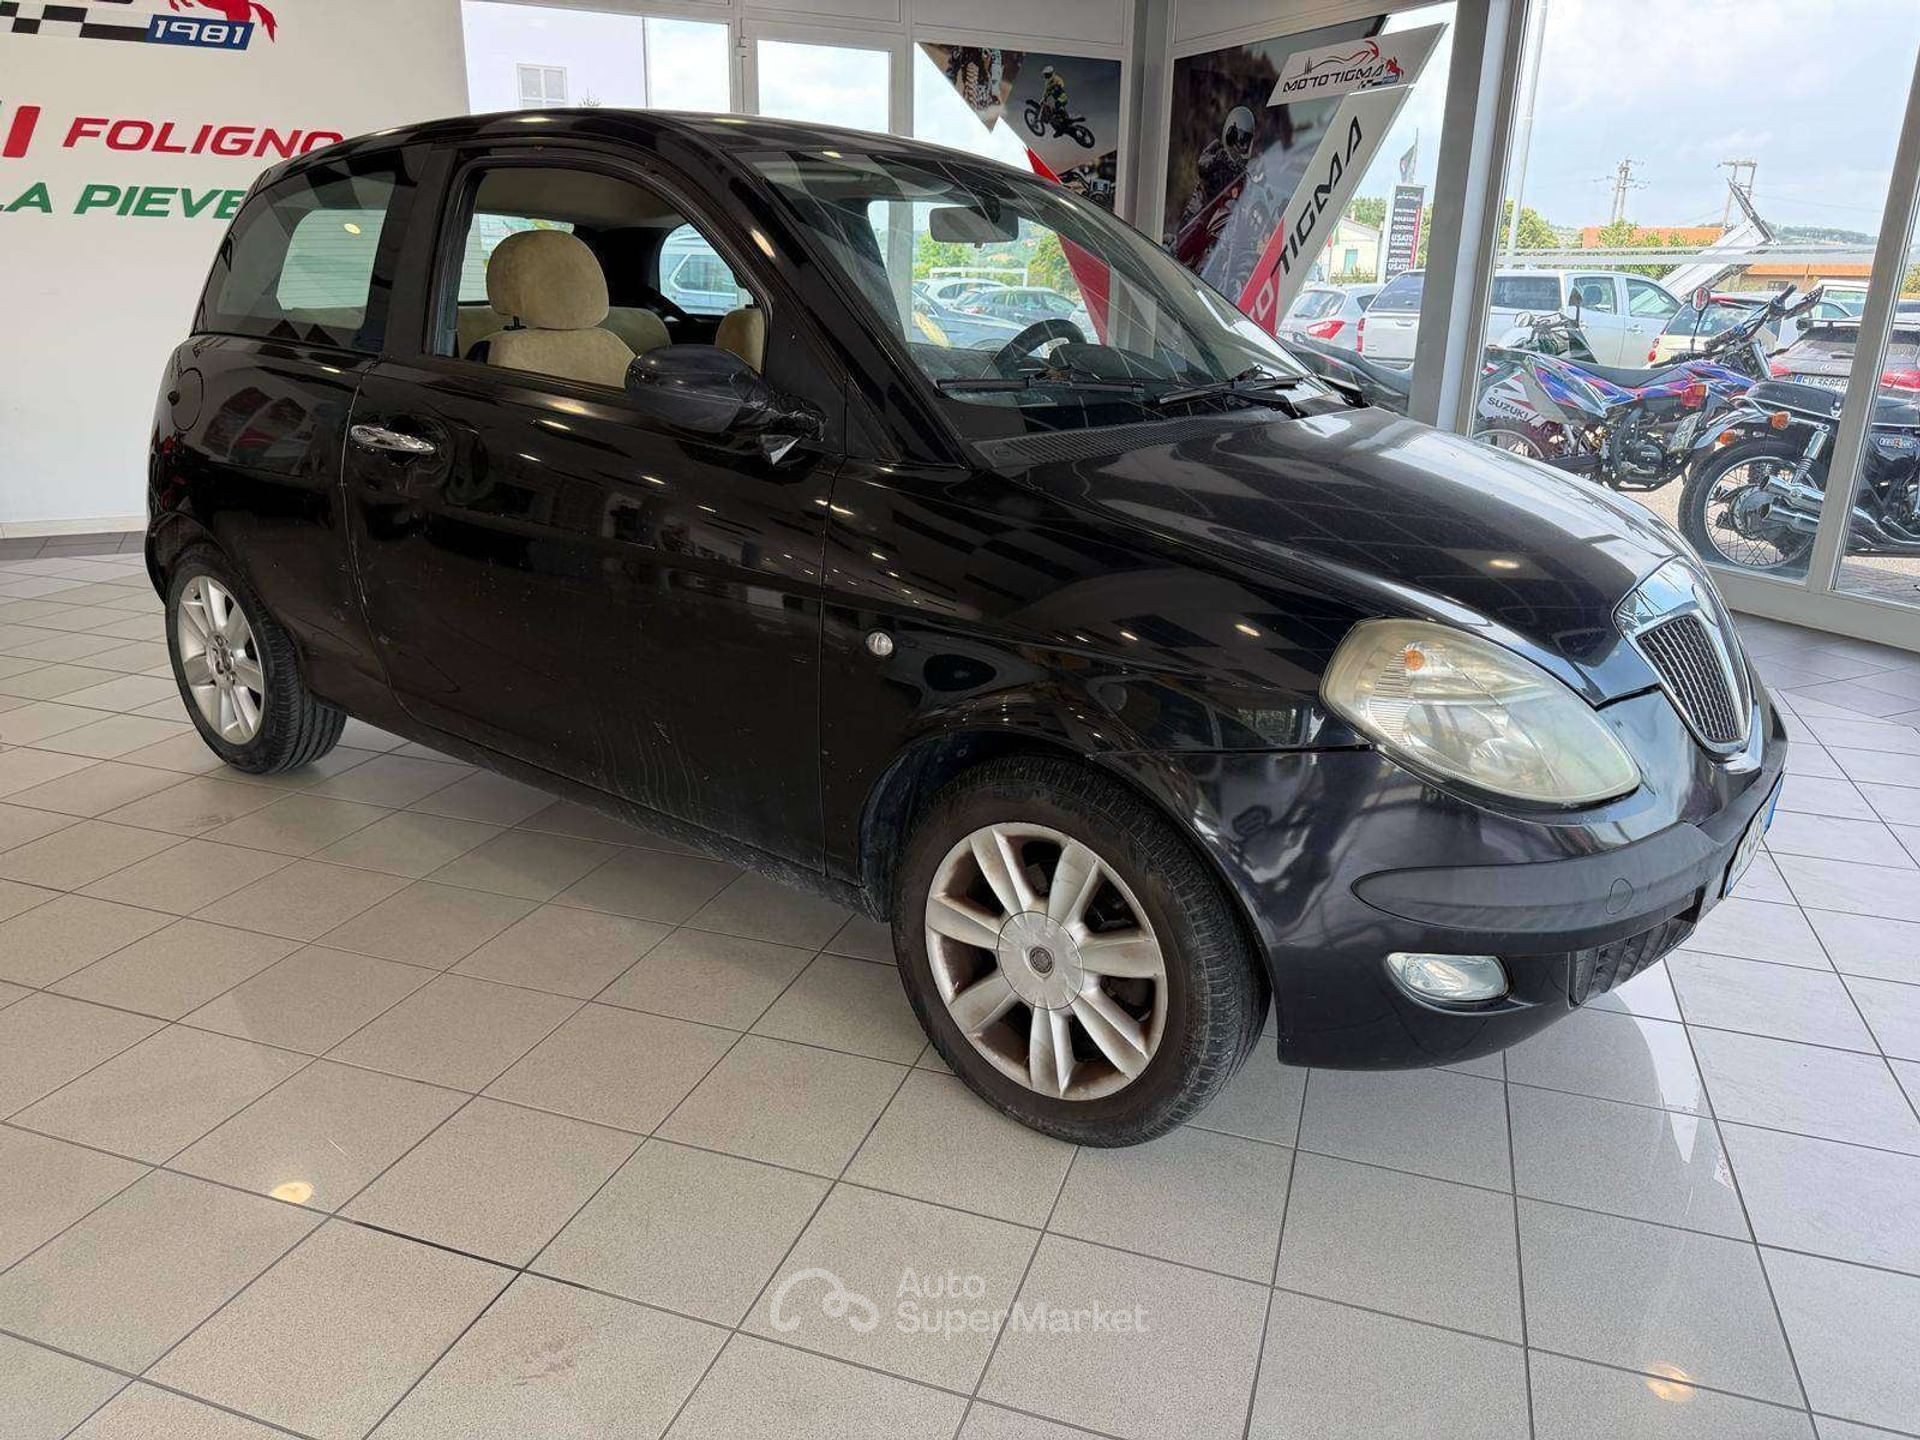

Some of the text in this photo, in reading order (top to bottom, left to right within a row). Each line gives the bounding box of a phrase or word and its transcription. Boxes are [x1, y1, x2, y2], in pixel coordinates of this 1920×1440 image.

[154, 20, 244, 44] 1981
[1282, 64, 1385, 93] MOTOTIGMA
[73, 184, 248, 219] PIEVE
[1487, 397, 1529, 420] SUZUKI
